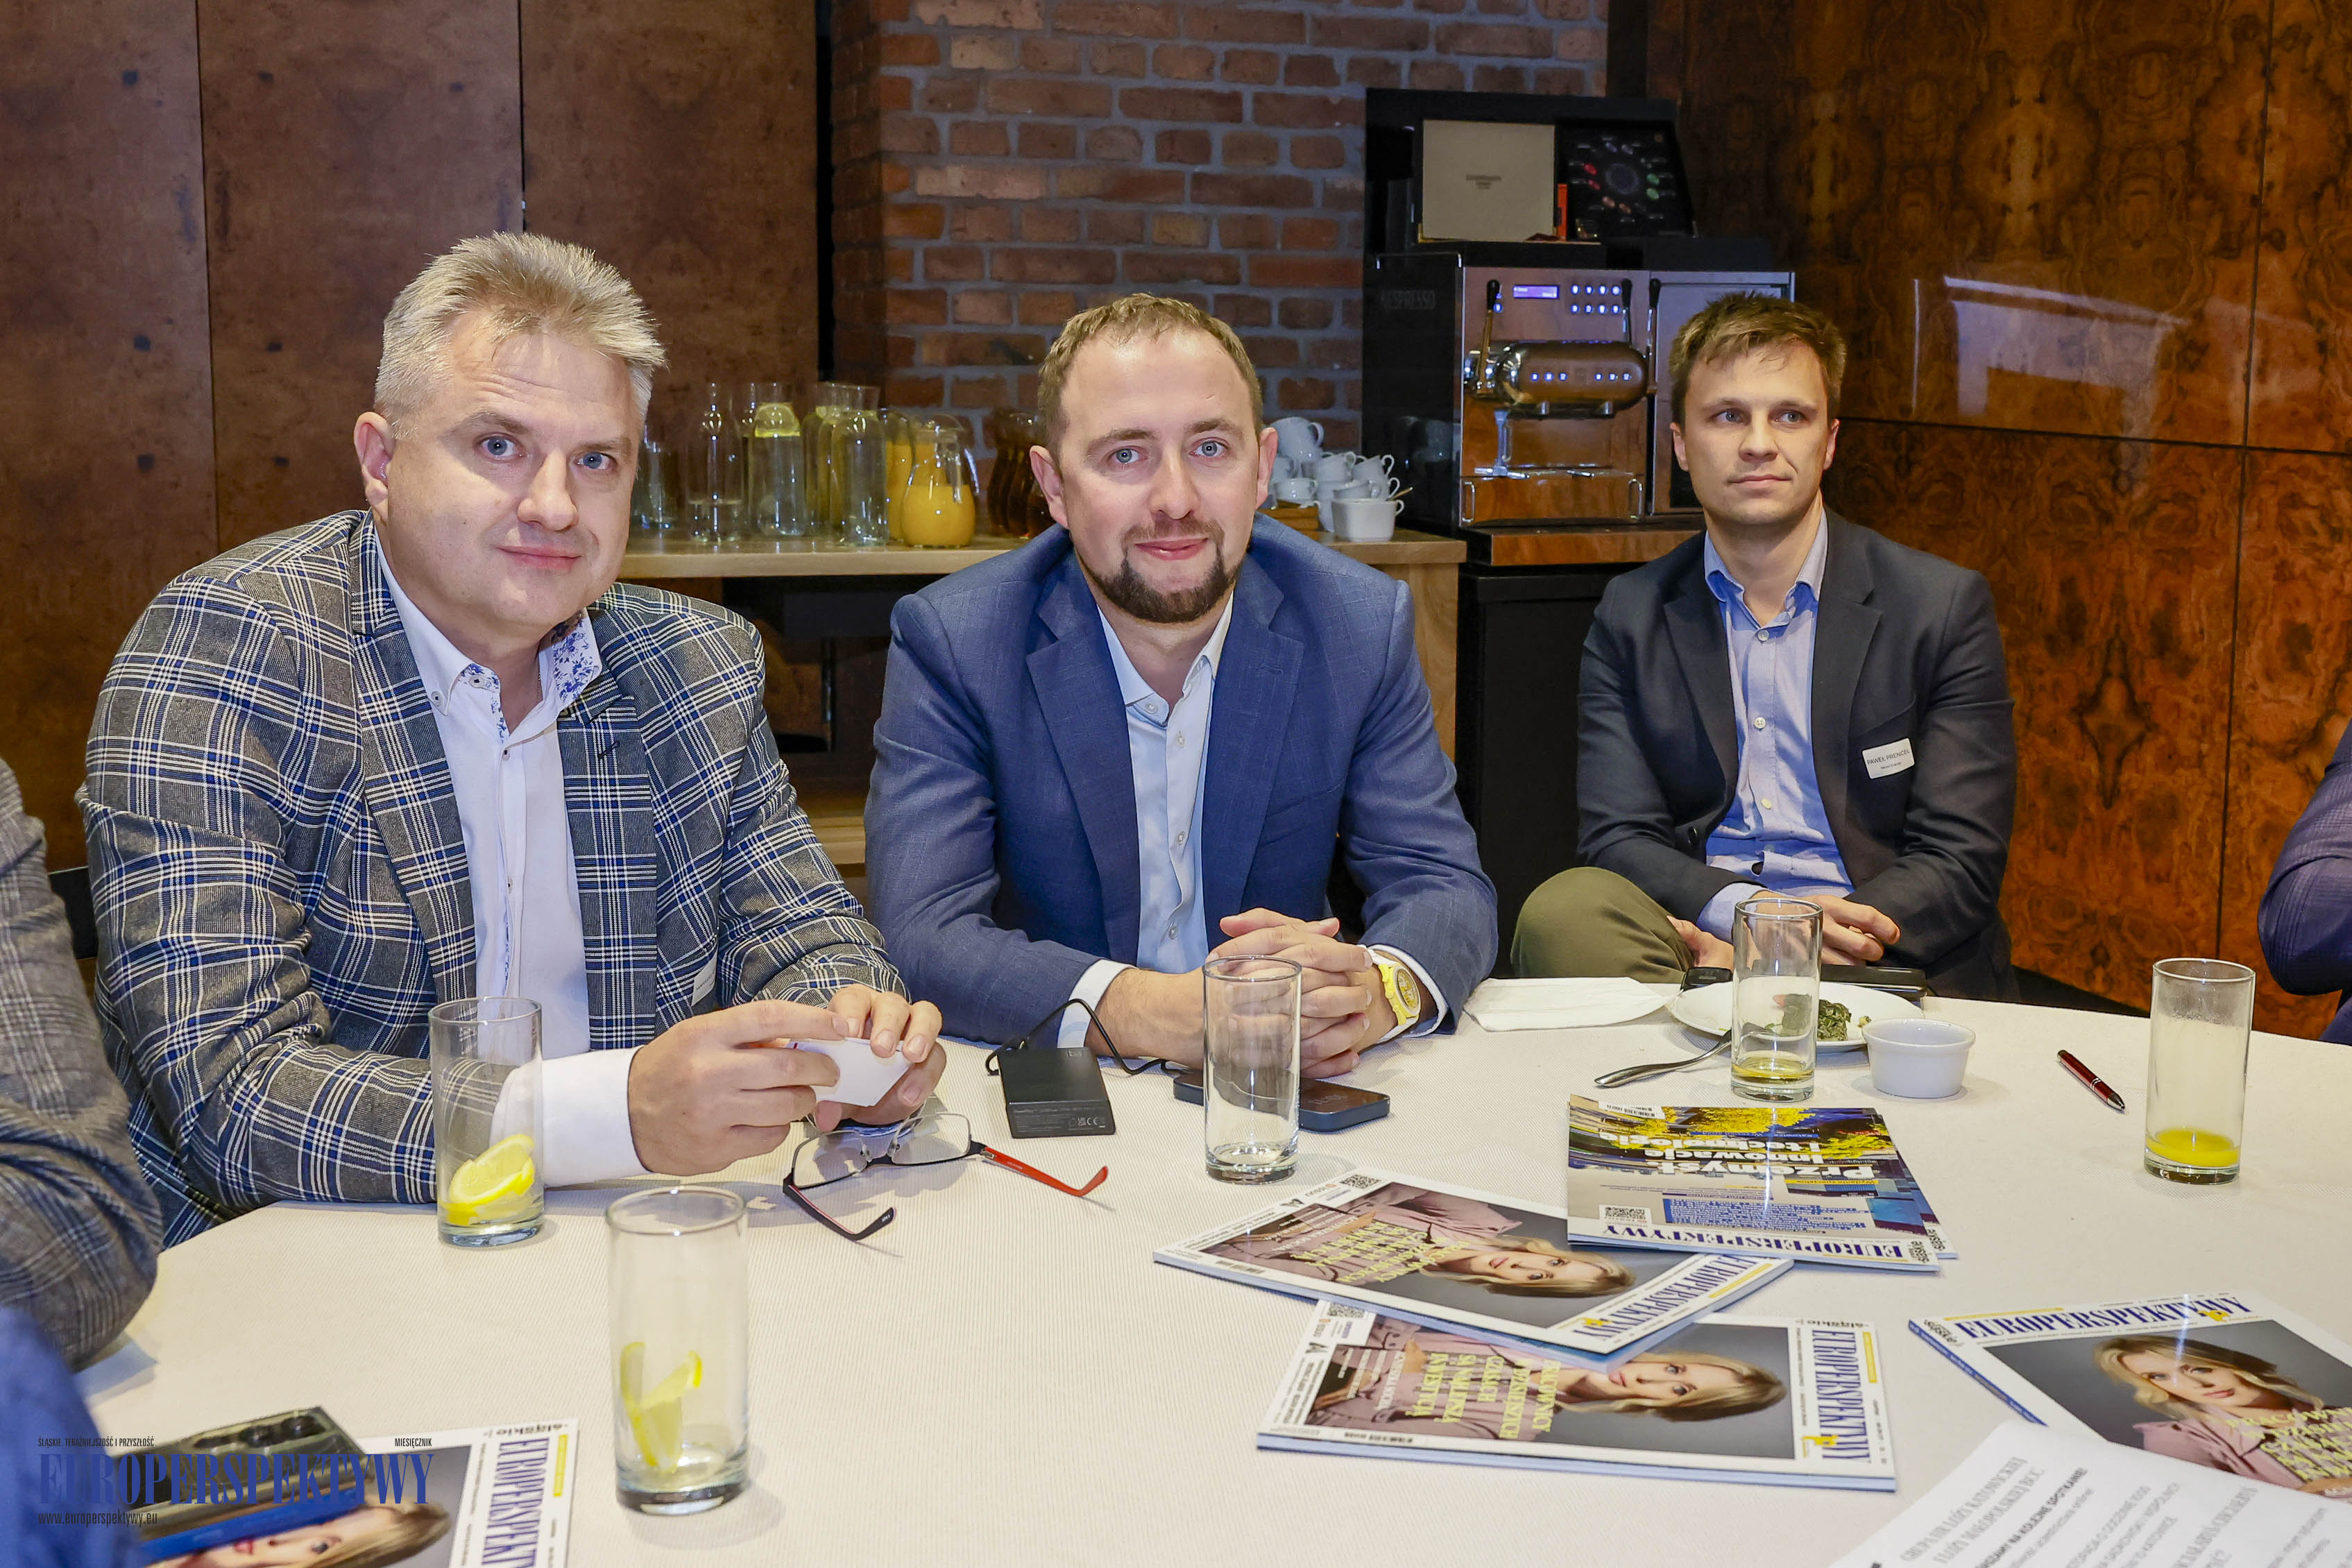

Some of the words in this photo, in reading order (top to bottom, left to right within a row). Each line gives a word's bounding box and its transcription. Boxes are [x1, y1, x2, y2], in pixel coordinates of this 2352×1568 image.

[1598, 1132, 1805, 1151] technologie
[1644, 1149, 1823, 1164] Innowacje
[1603, 1225, 1902, 1258] EUROPERSPEKTYWY
[1954, 1296, 2253, 1339] EUROPERSPEKTYWY
[1812, 1329, 1872, 1459] EUROPERSPEKTYWY
[481, 1437, 549, 1568] EUROPERSPEKT
